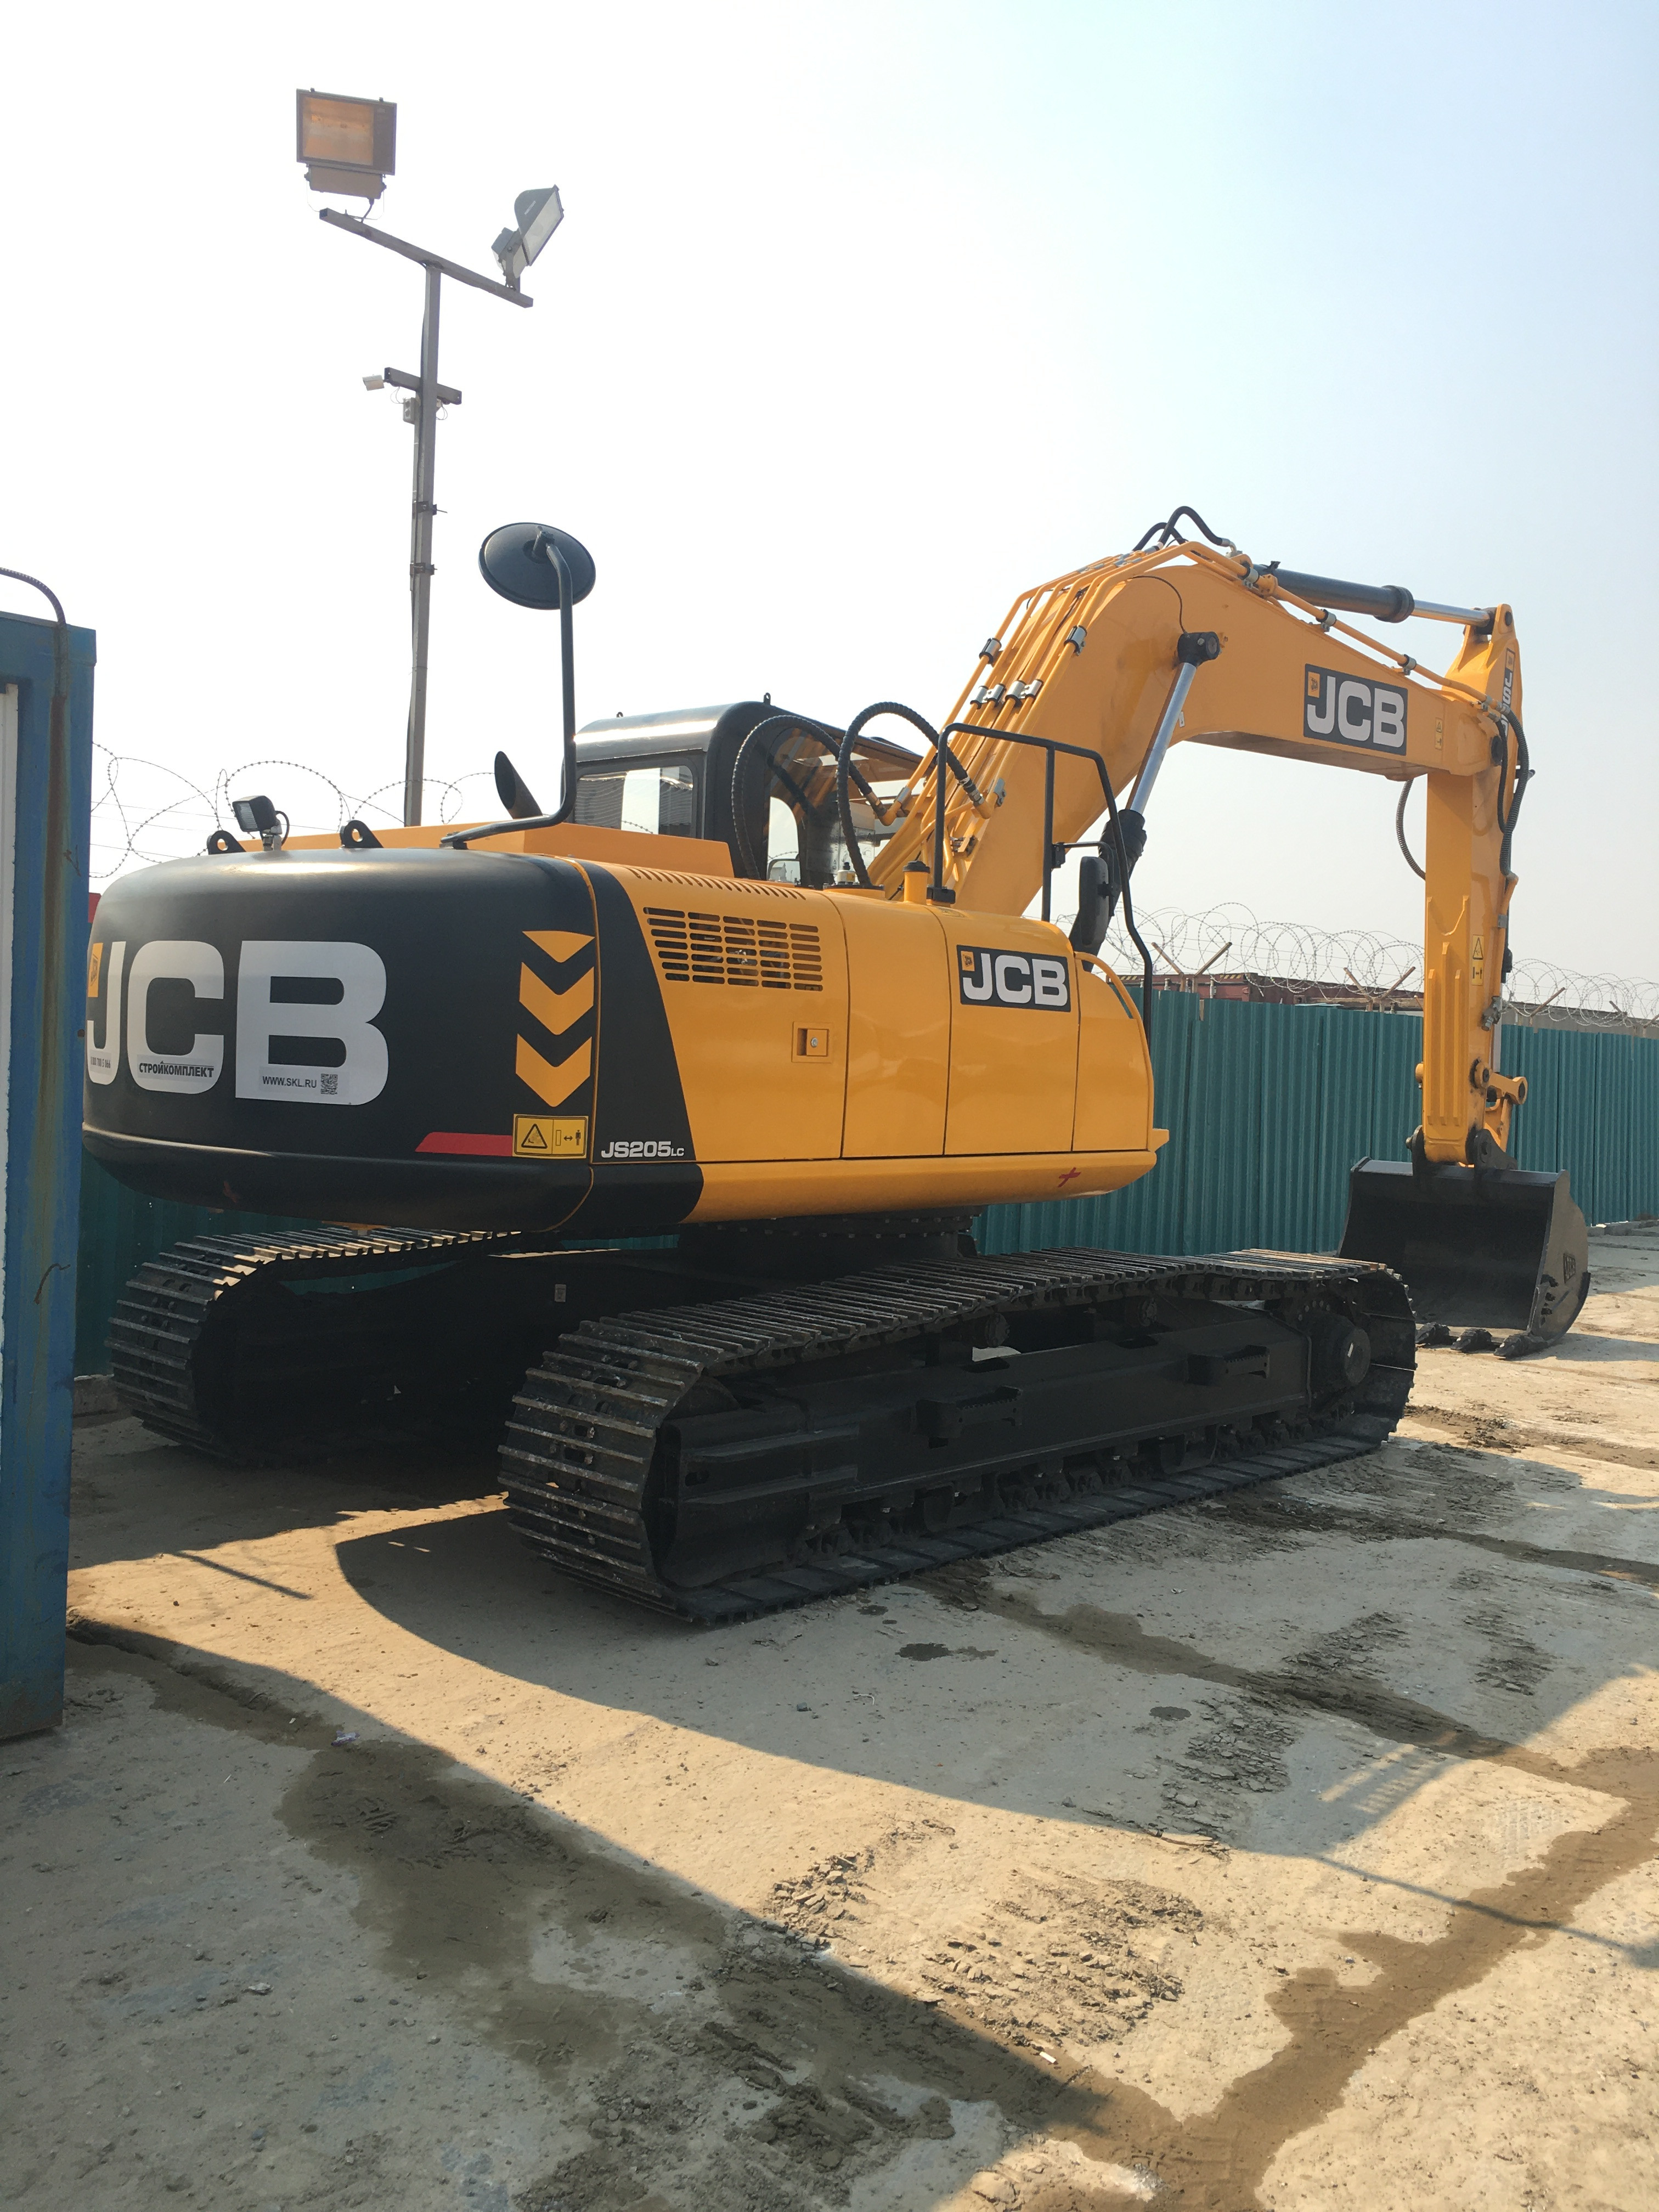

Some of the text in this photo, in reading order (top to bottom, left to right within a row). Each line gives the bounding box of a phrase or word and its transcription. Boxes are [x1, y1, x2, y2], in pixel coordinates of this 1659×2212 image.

[1307, 676, 1404, 747] JCB
[963, 953, 1067, 1006] JCB
[87, 940, 389, 1105] JCB
[139, 1062, 215, 1077] СТРОЙКОМПЛЕКТ
[262, 1076, 317, 1088] WWW.SKL.RU
